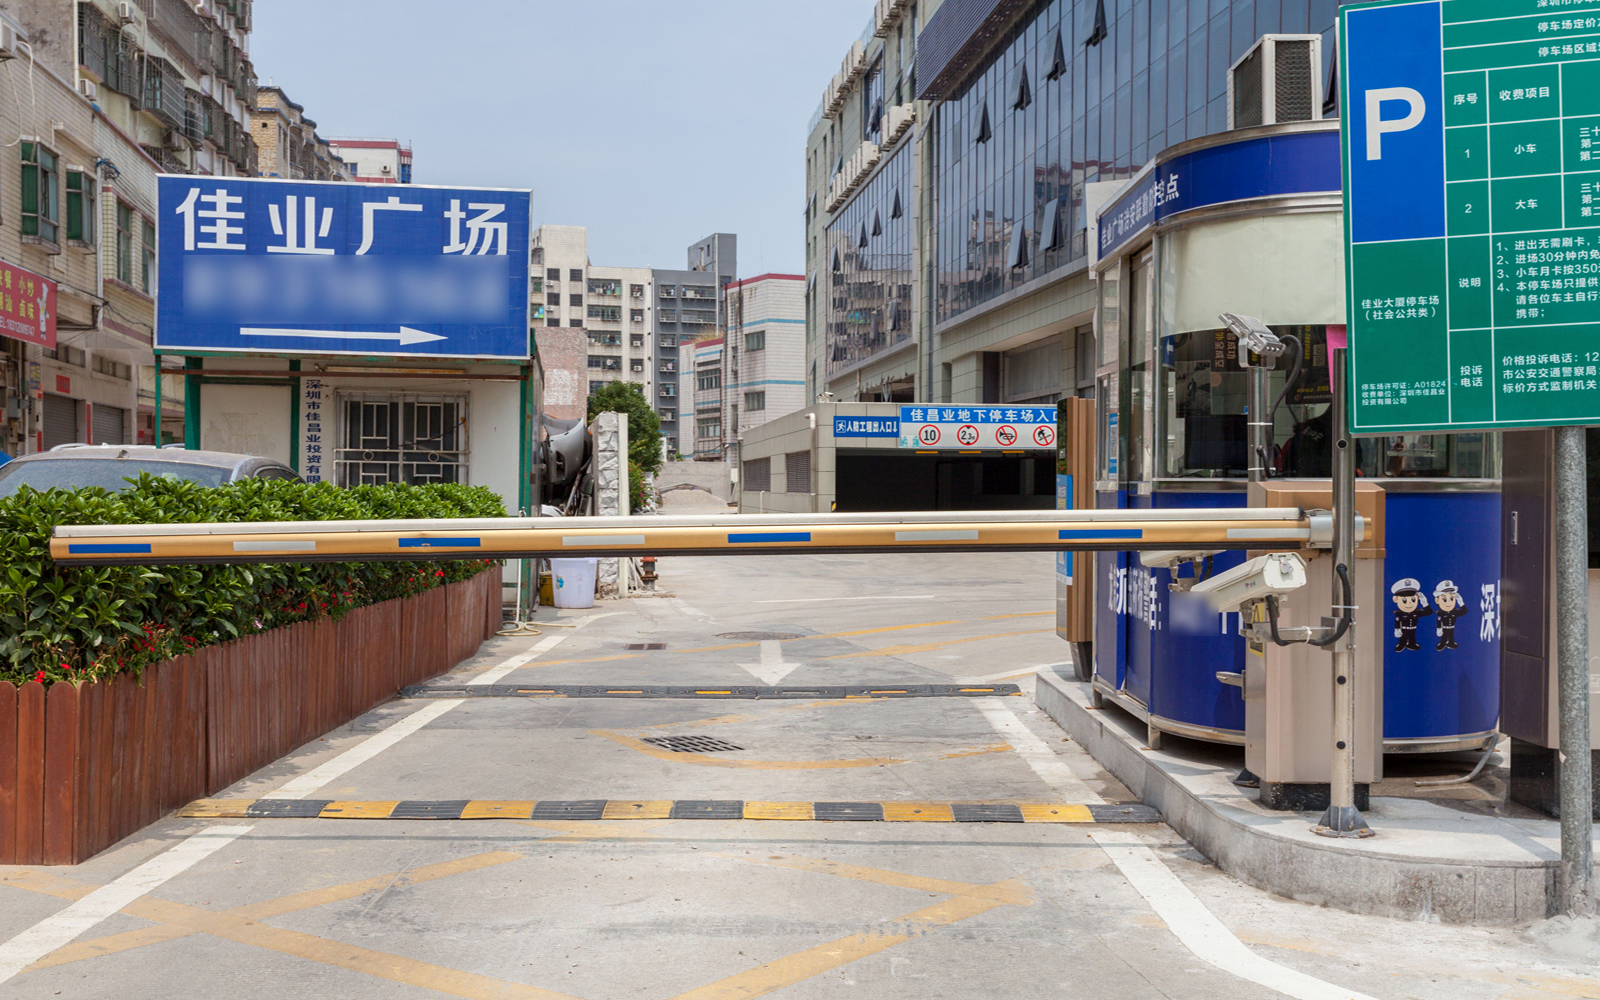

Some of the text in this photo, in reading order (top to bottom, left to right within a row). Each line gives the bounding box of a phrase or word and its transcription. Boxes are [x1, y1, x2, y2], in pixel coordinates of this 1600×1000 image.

[1453, 93, 1478, 106] 序号
[1499, 87, 1550, 102] 收费项目
[1365, 87, 1426, 161] P
[1464, 149, 1470, 159] 1
[1514, 144, 1537, 155] 小车
[1464, 204, 1472, 214] 2
[1515, 199, 1538, 210] 大车
[175, 187, 508, 256] 佳业广场
[1496, 235, 1600, 251] 1、进出无需刷卡，
[1496, 263, 1600, 279] 3、小车月卡按350
[1458, 278, 1481, 288] 说明
[1361, 295, 1440, 309] 佳业大厦停车场
[1515, 291, 1600, 305] 请各位车主自行
[1365, 307, 1436, 321] （社会公共类）
[1460, 365, 1483, 376] 投诉
[1502, 365, 1600, 380] 市公安交通警察局
[1460, 377, 1483, 388] 电话
[1502, 380, 1600, 393] 标价方式监制机关
[305, 379, 322, 484] 深圳市佳昌业投资有限
[924, 429, 937, 442] 10
